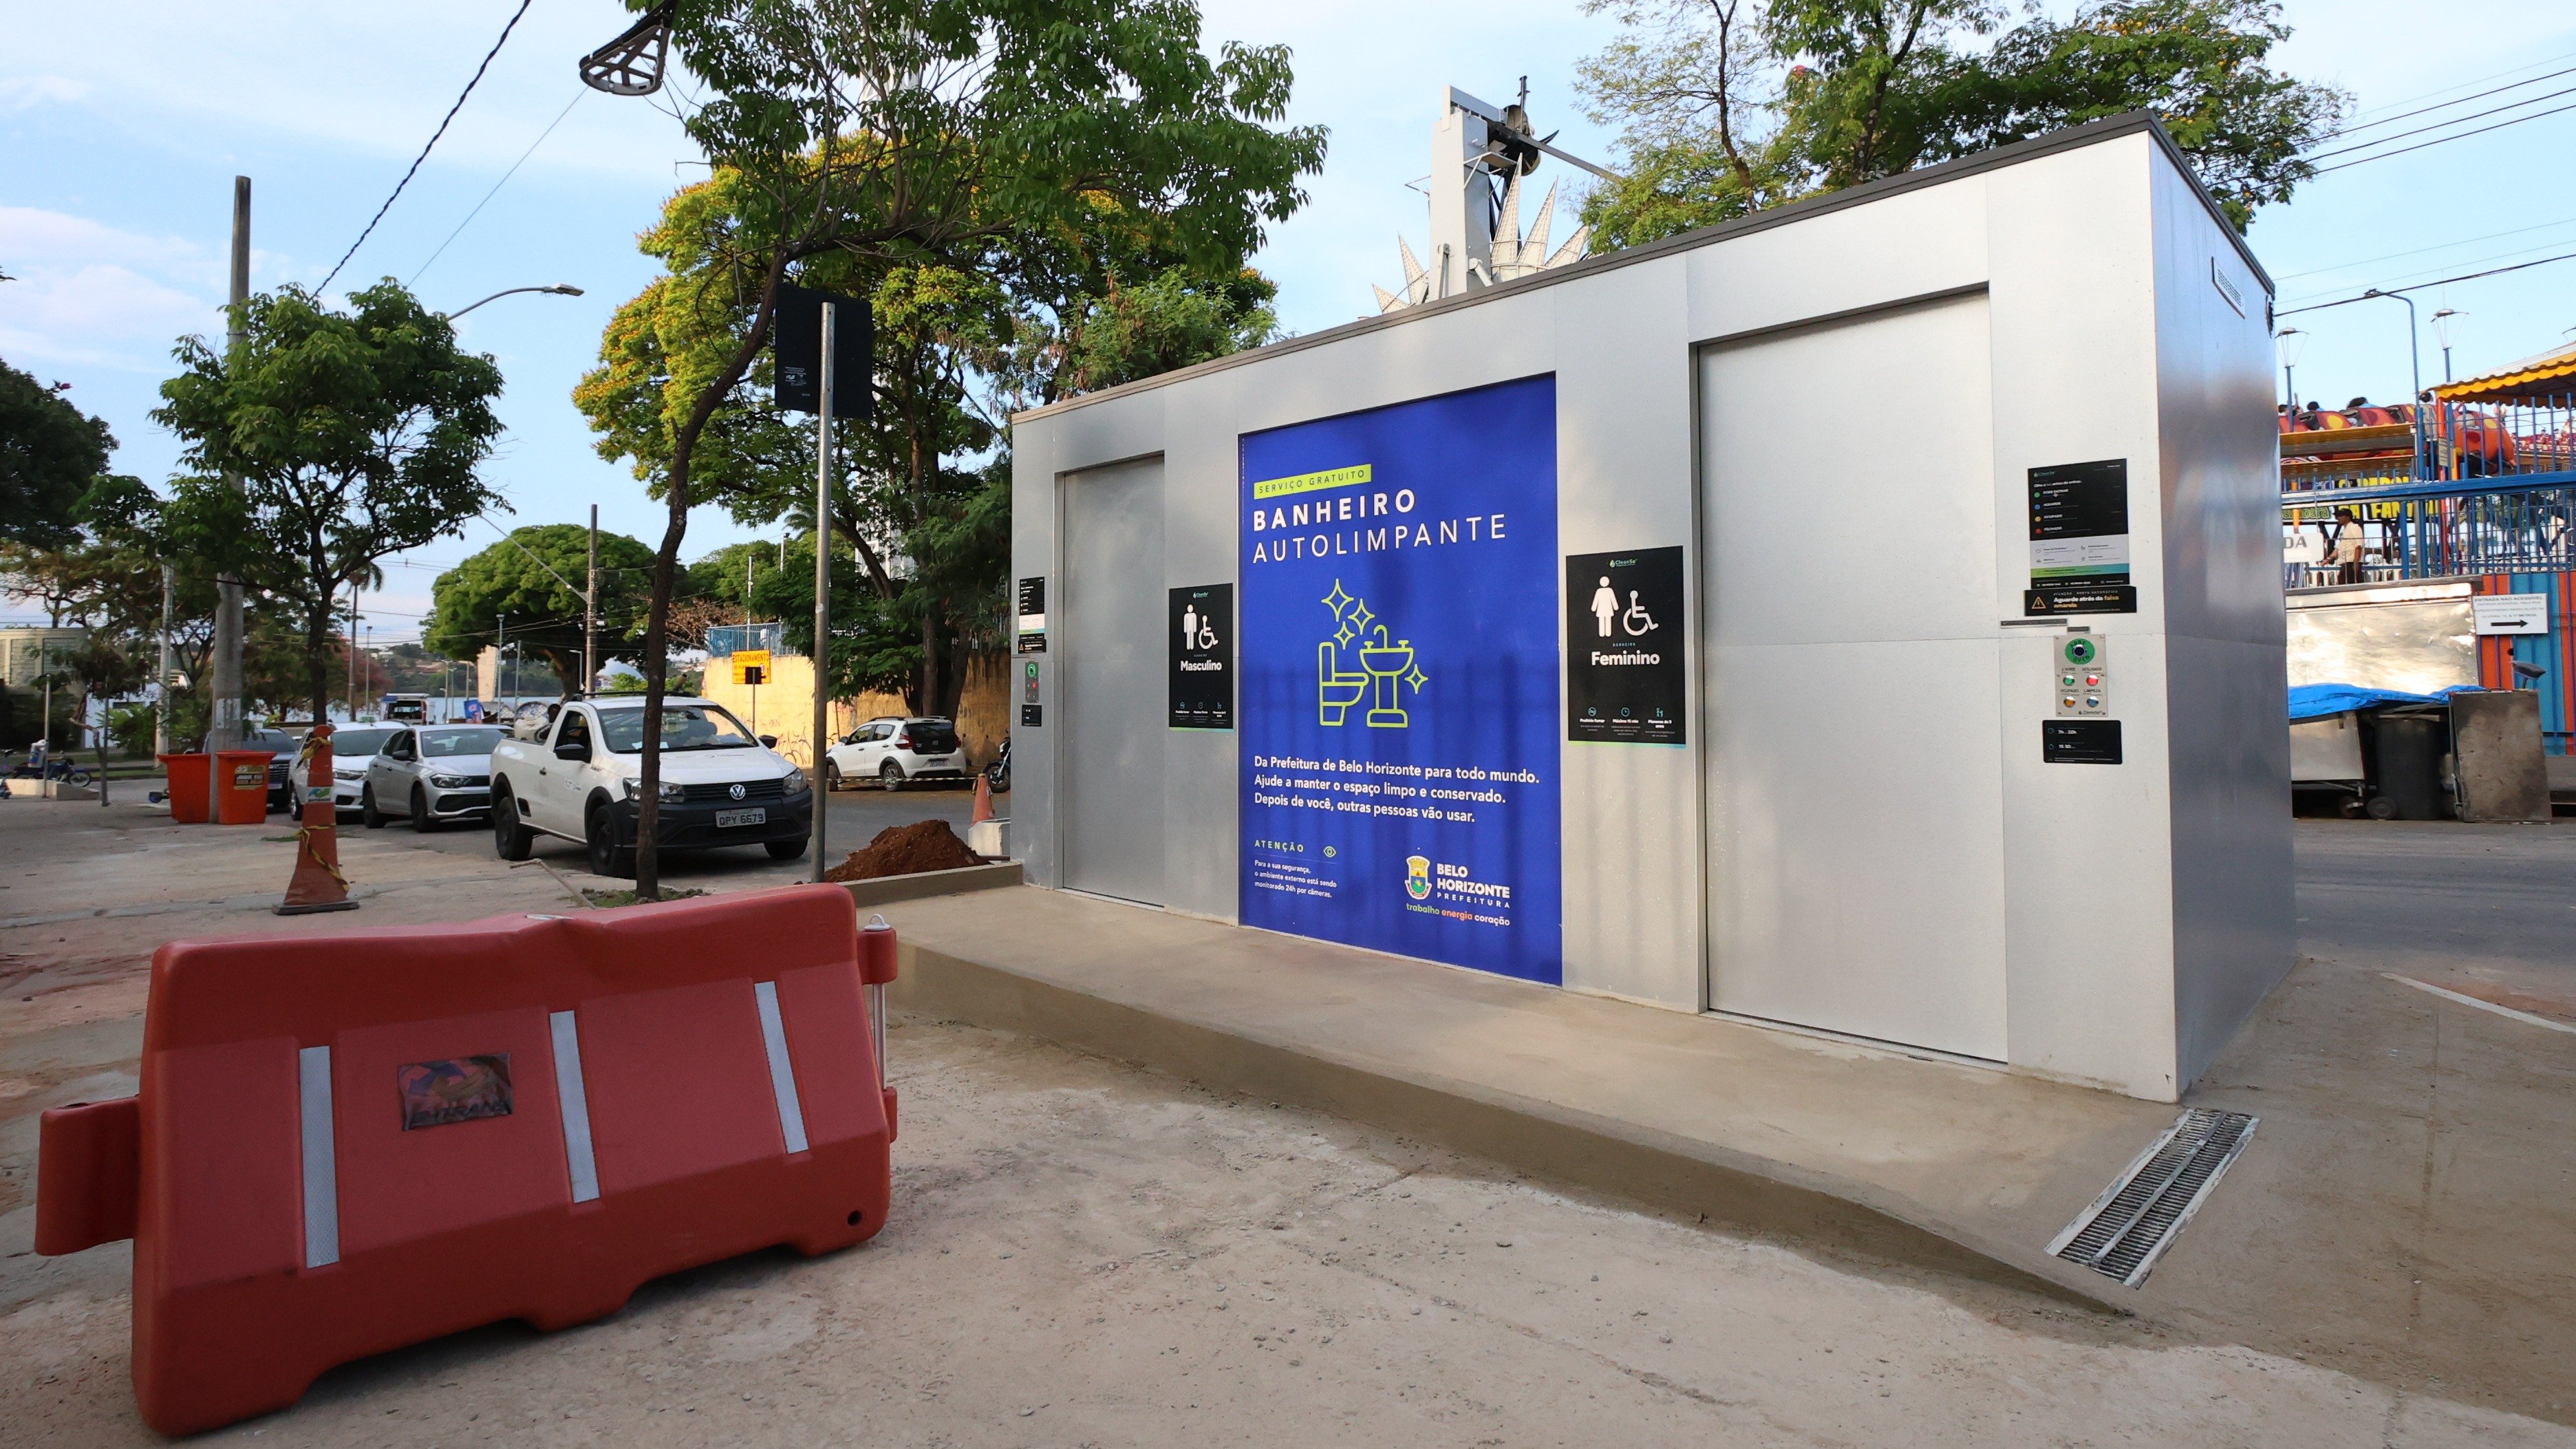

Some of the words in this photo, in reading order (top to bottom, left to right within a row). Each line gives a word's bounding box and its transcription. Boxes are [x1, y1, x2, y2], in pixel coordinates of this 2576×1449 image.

[1259, 480, 1303, 493] SERVIÇO
[1309, 469, 1364, 486] GRATUITO
[1254, 489, 1415, 531] BANHEIRO
[1253, 514, 1505, 564] AUTOLIMPANTE
[733, 654, 769, 663] ESTACIONAMENTO
[1181, 660, 1222, 671] Masculino
[1591, 650, 1660, 666] Feminino
[1254, 756, 1267, 767] Da
[1271, 757, 1320, 771] Prefeitura
[1322, 759, 1336, 771] de
[1339, 760, 1362, 773] Belo
[1366, 762, 1421, 776] Horizonte
[1425, 767, 1452, 780] para
[1456, 766, 1485, 780] todo
[1490, 769, 1540, 784] mundo.
[1254, 775, 1283, 788] Ajude
[1285, 779, 1291, 787] a
[1294, 777, 1330, 790] manter
[1333, 782, 1340, 791] o
[1344, 783, 1380, 796] espaço
[1384, 782, 1416, 798] limpo
[1420, 788, 1426, 797] e
[1431, 786, 1506, 804] conservado.
[1254, 793, 1289, 808] Depois
[1291, 795, 1304, 807] de
[1307, 797, 1334, 811] você,
[1338, 801, 1371, 813] outras
[1374, 804, 1418, 818] pessoas
[1421, 806, 1443, 819] vão
[1447, 810, 1474, 823] usar.
[740, 813, 764, 824] 6679
[1254, 839, 1303, 852] ATENÇÃO
[1282, 864, 1311, 874] segurança,
[1437, 863, 1468, 877] BELO
[1260, 872, 1283, 880] ambiente
[1285, 875, 1305, 883] externo
[1255, 881, 1285, 891] monitorado
[1308, 888, 1332, 898] câmeras.
[1437, 878, 1510, 899] HORIZONTE
[1437, 892, 1510, 908] PREFEITURA
[1406, 903, 1440, 914] trabalho
[1441, 909, 1472, 921] energia
[1474, 914, 1510, 926] coração
